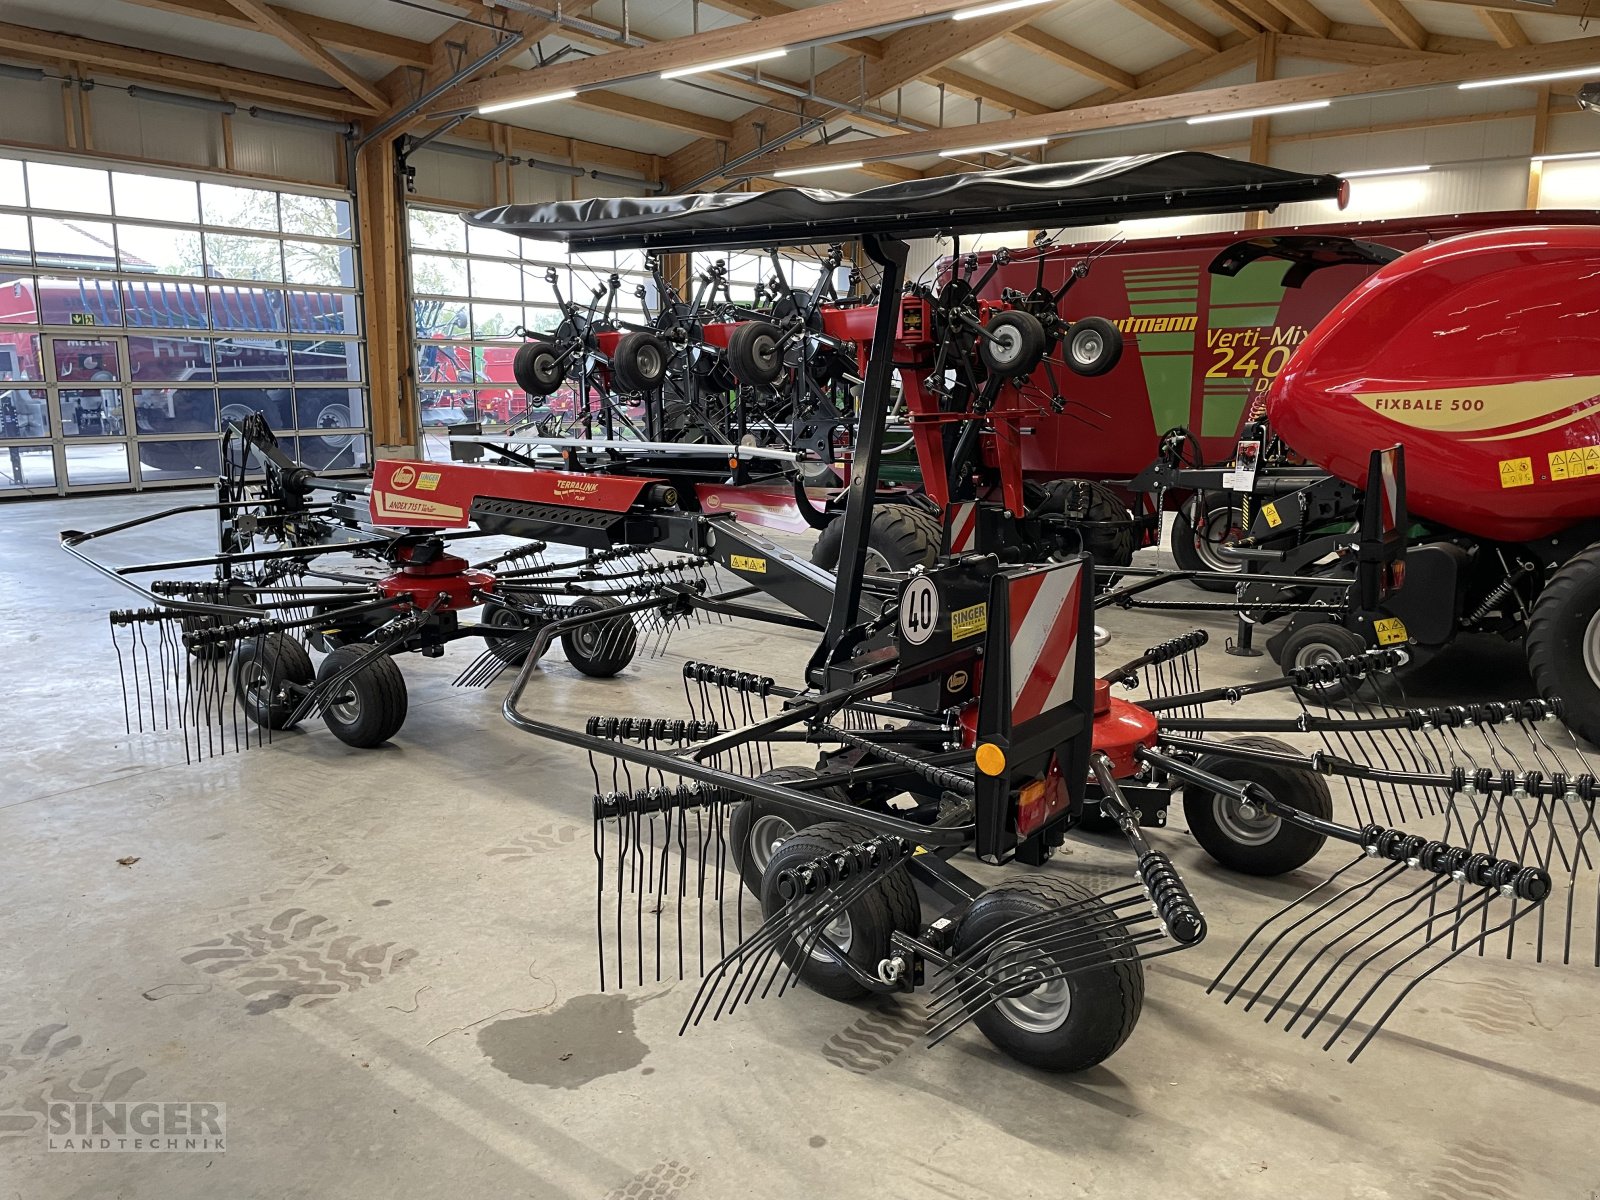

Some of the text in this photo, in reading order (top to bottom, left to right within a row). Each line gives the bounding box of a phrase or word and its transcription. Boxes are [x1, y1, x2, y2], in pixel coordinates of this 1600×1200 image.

[1111, 316, 1198, 333] utmann
[1205, 346, 1290, 377] 240
[1375, 399, 1484, 411] FIXBALE 500
[557, 480, 599, 491] TERRALINK
[389, 501, 408, 510] ANDEX
[909, 588, 931, 632] 40
[952, 605, 985, 625] SINGER
